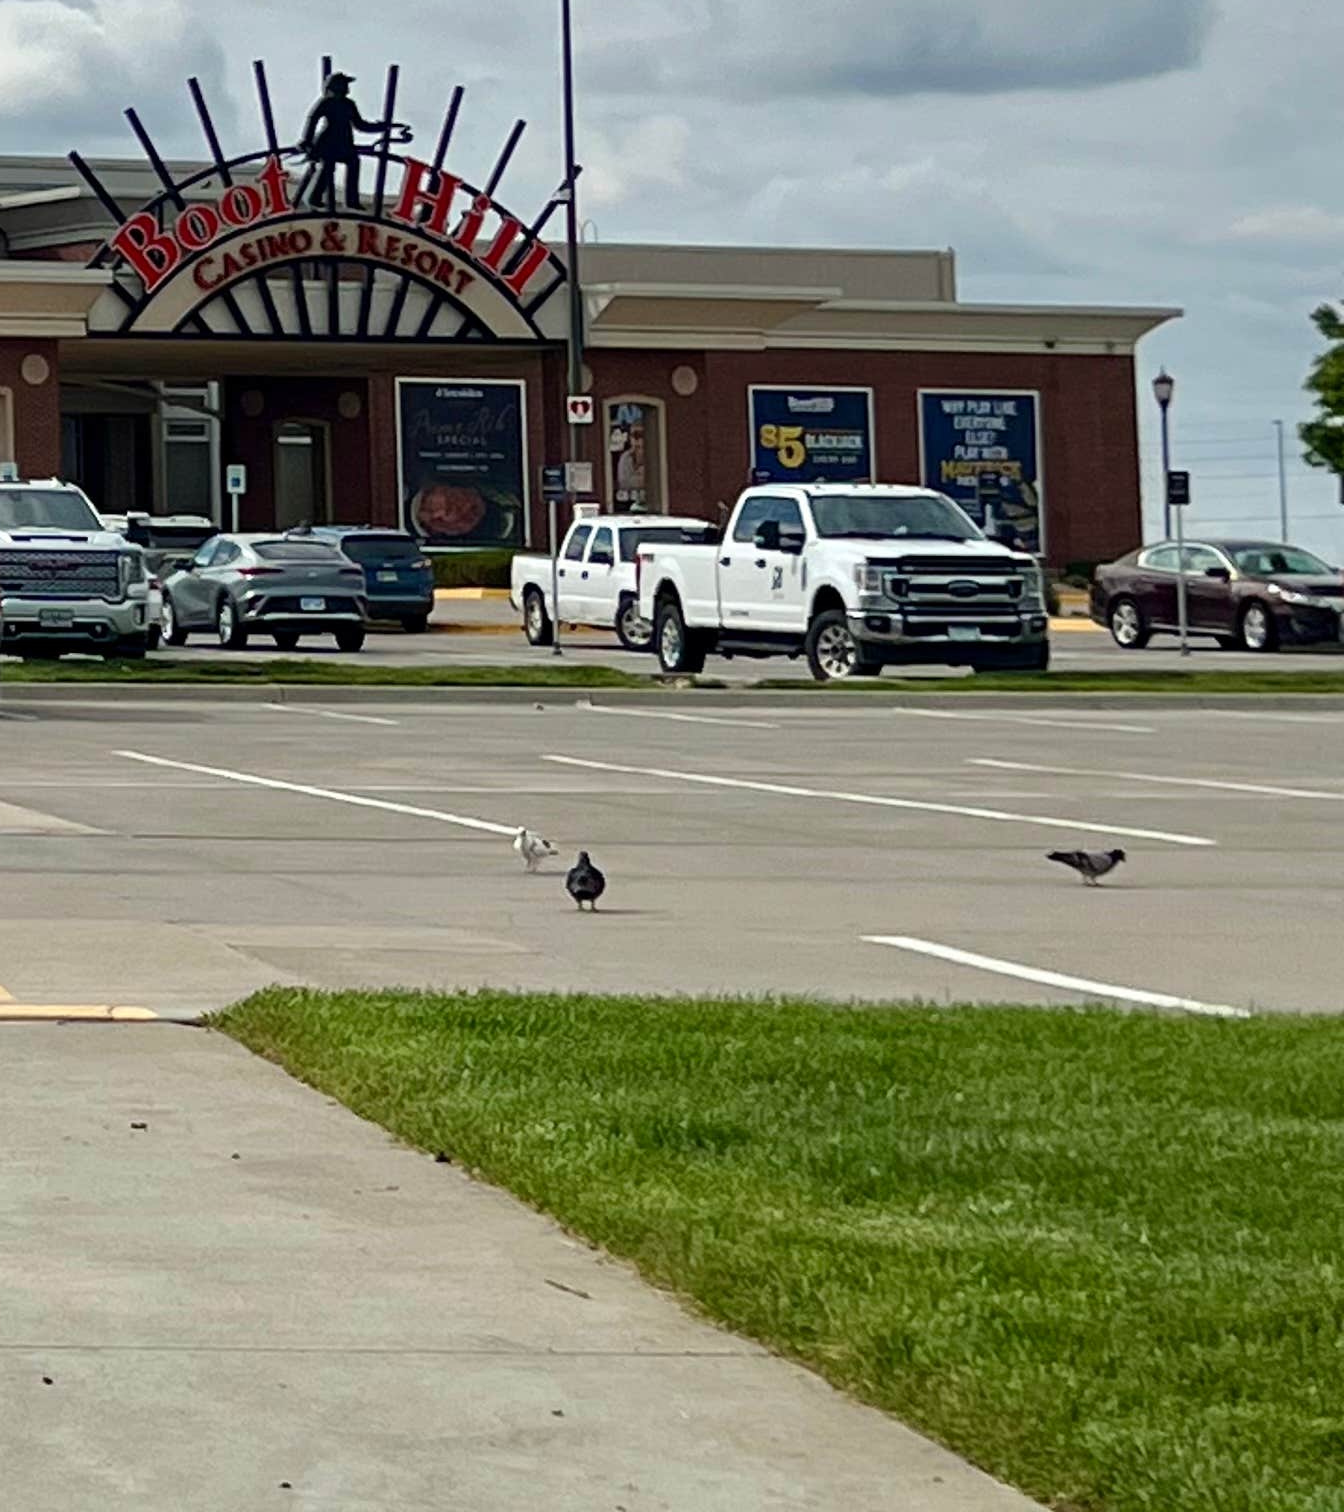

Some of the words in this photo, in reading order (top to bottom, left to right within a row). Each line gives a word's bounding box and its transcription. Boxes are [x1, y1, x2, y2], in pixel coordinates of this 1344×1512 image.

[111, 153, 295, 294] Boot
[388, 155, 551, 297] Hill
[192, 228, 312, 291] CASINO
[319, 220, 346, 251] &
[357, 223, 476, 295] RESORT
